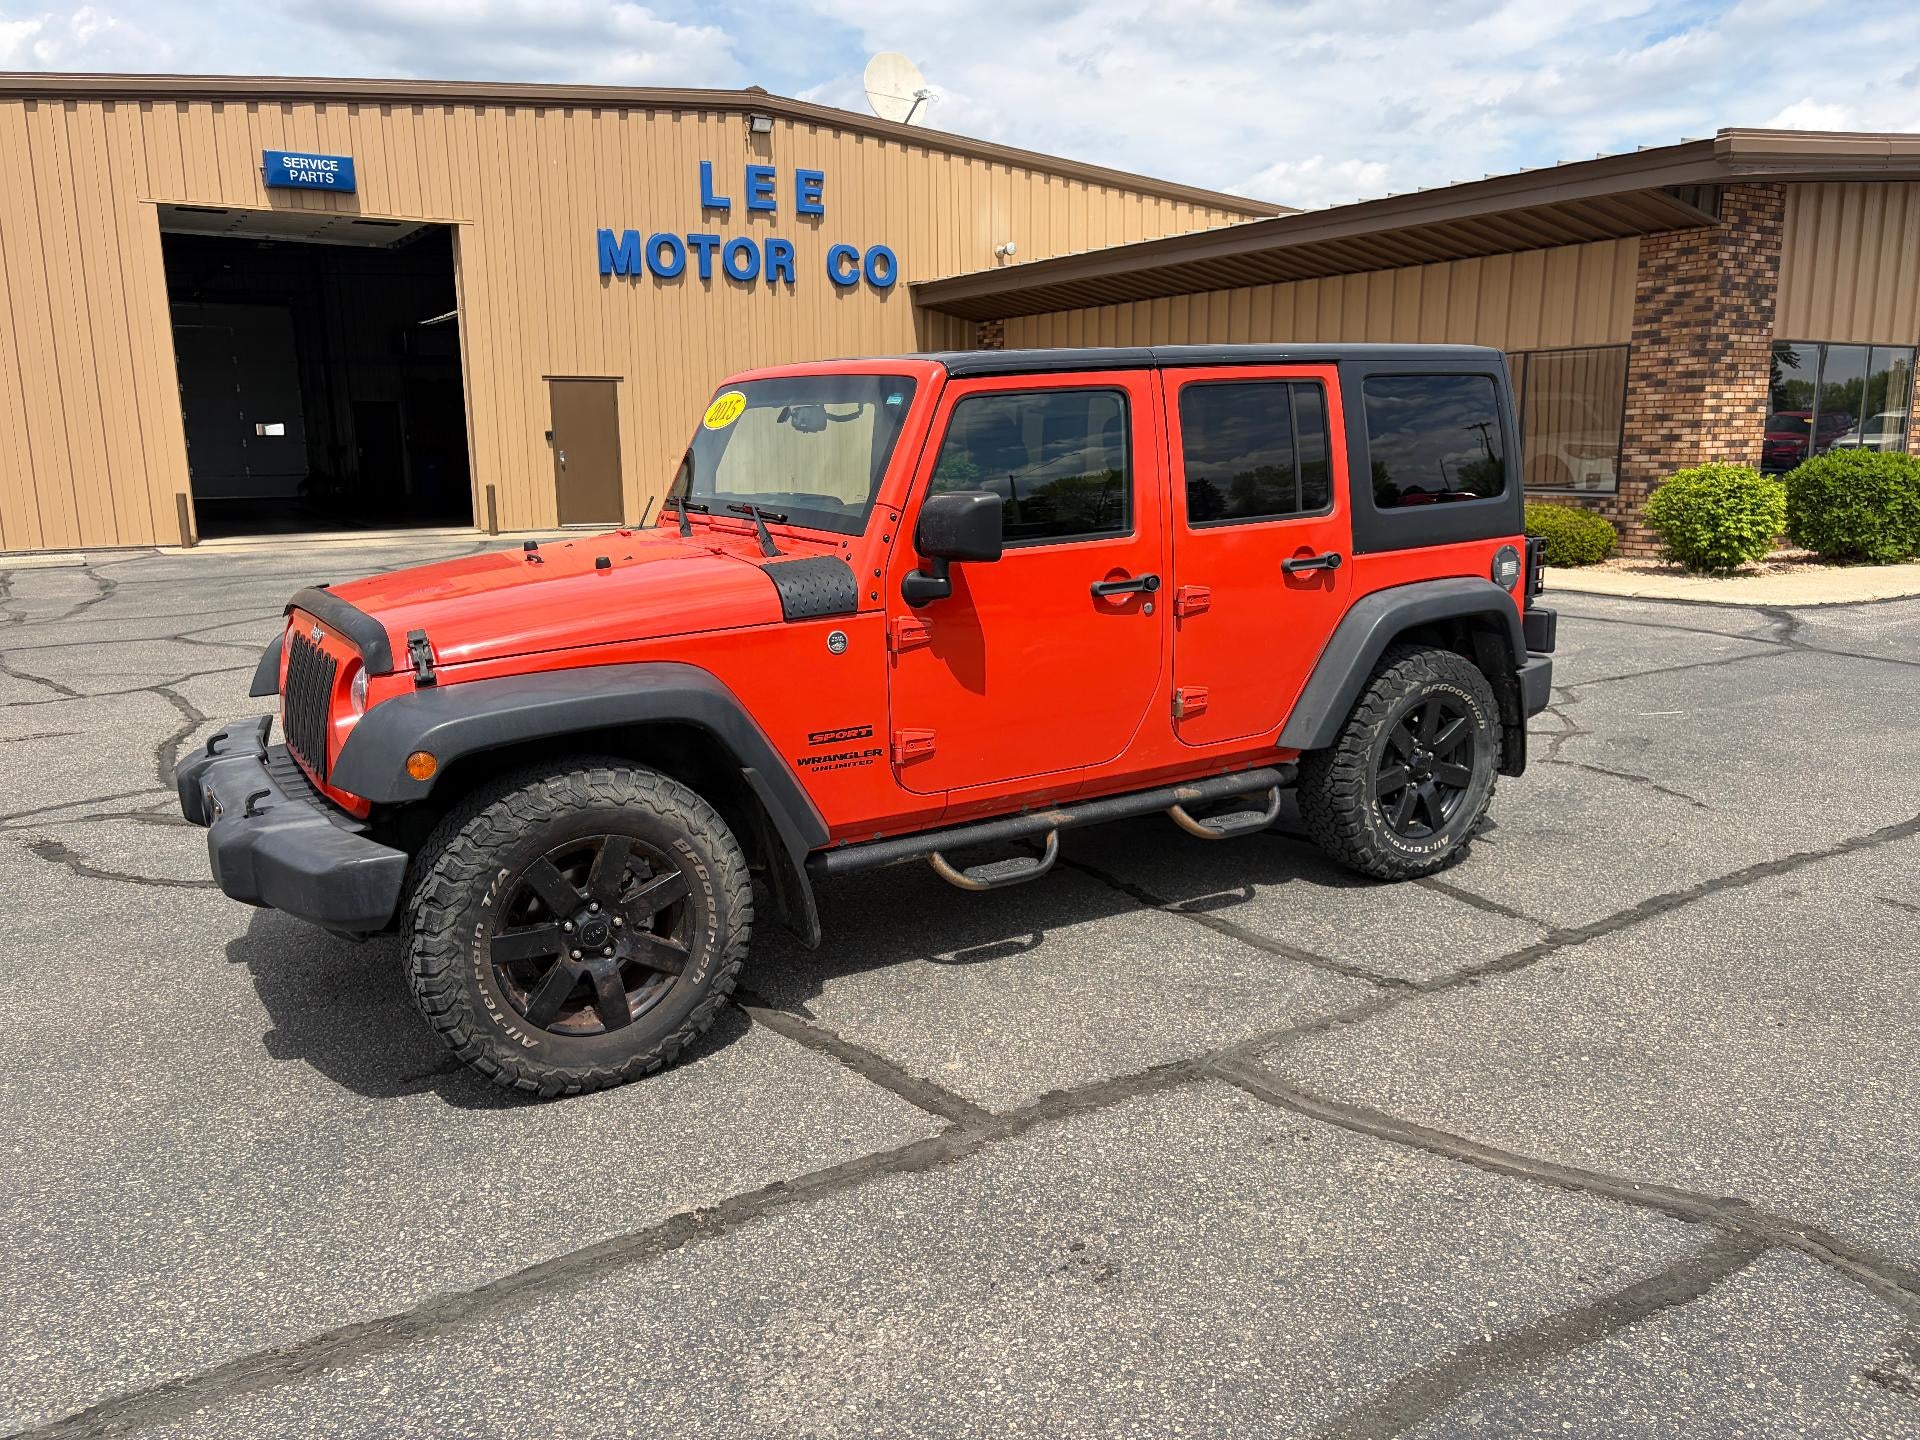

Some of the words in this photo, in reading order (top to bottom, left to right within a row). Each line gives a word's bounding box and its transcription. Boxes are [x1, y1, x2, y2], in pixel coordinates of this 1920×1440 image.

[283, 156, 338, 171] SERVICE
[289, 169, 334, 183] PARTS
[699, 160, 825, 216] LEE
[597, 228, 795, 283] MOTOR
[826, 243, 898, 288] CO
[707, 399, 743, 423] 2015
[810, 727, 870, 744] SPORT
[797, 748, 883, 766] WRANGLER
[811, 759, 873, 773] UNLIMITED
